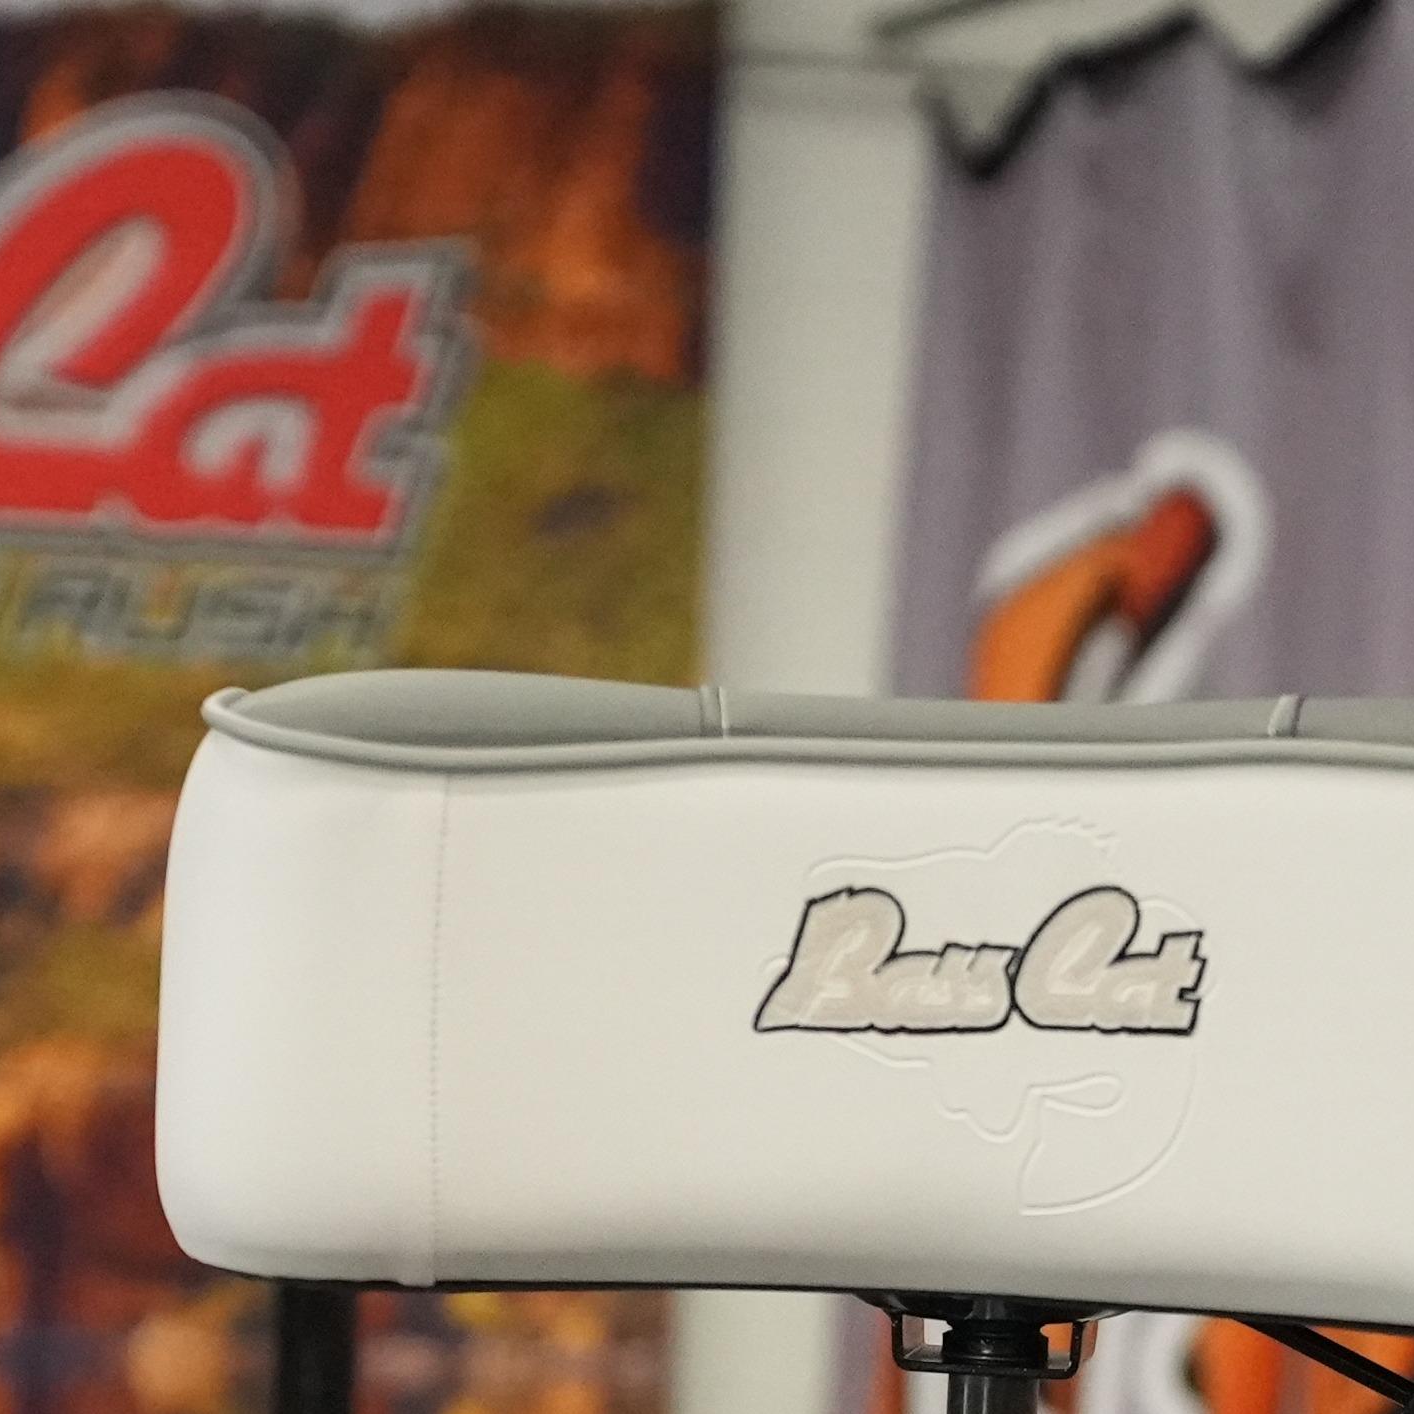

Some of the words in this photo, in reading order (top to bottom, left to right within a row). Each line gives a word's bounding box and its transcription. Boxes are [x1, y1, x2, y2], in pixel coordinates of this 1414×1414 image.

[2, 560, 382, 665] RUSH
[753, 884, 1019, 1035] Bass
[1011, 884, 1209, 1036] Cat
